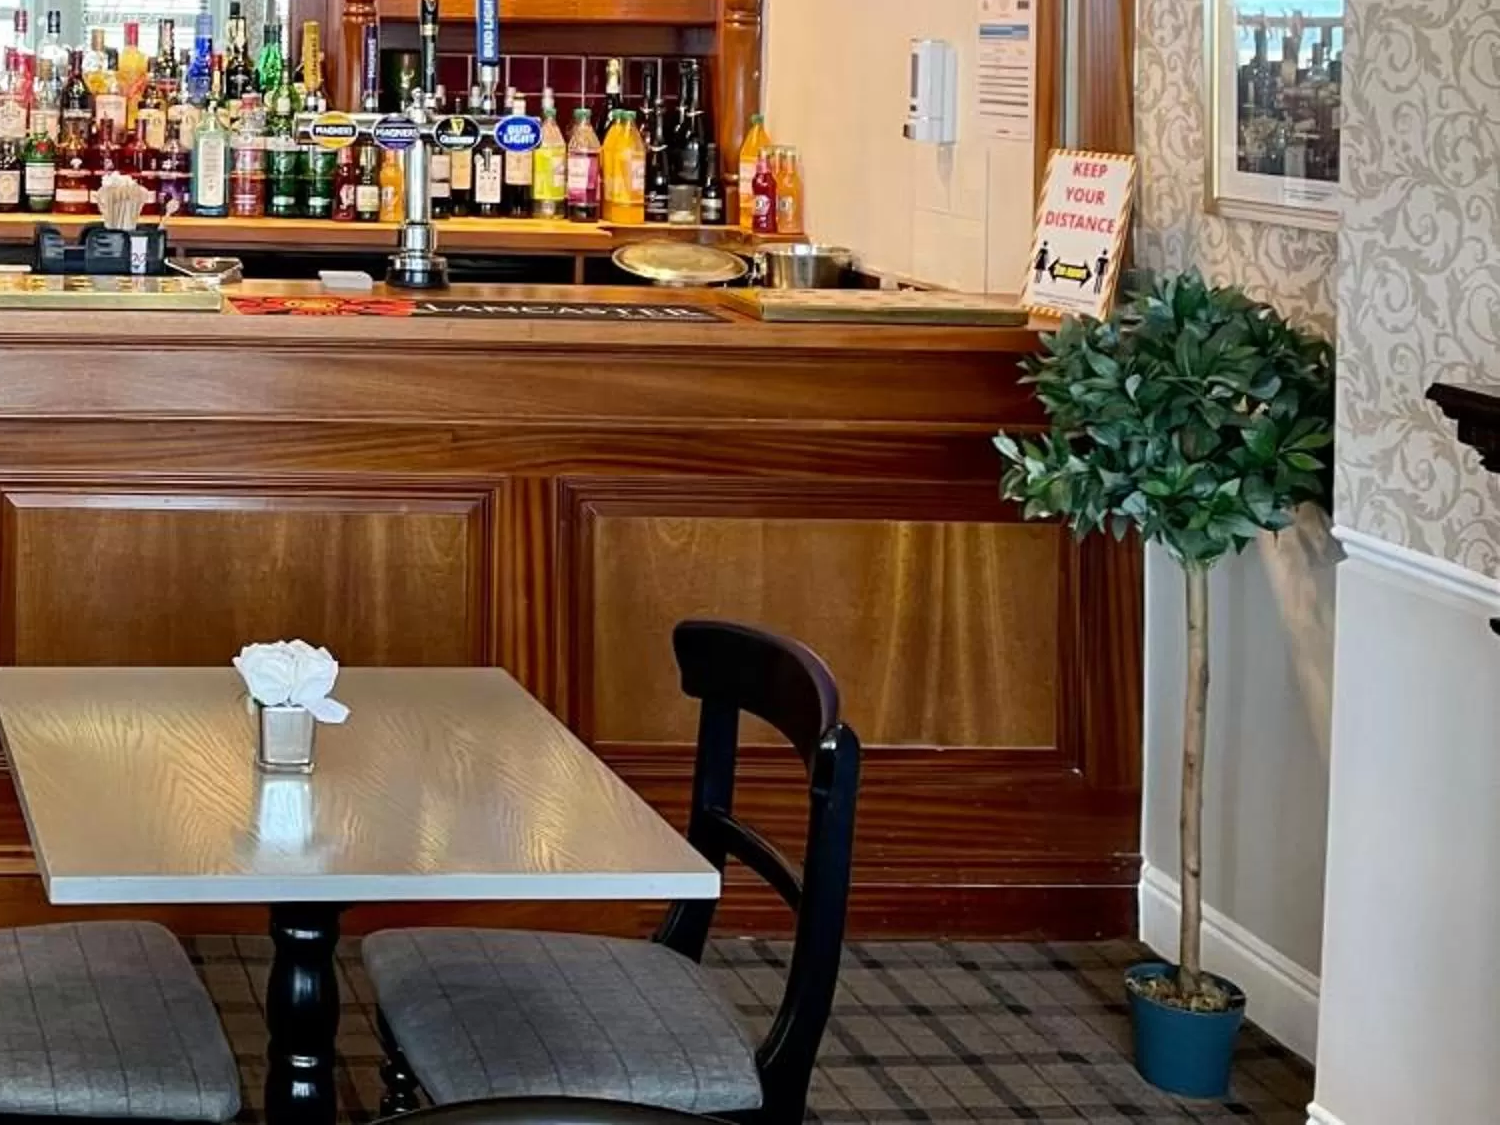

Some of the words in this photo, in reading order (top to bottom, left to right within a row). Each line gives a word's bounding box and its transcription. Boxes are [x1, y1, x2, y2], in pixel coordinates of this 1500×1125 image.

[482, 31, 495, 58] BUD
[376, 128, 418, 139] MAGNERS
[506, 123, 532, 135] BUD
[504, 133, 536, 144] LIGHT
[1072, 161, 1109, 178] KEEP
[1066, 186, 1106, 205] YOUR
[1045, 211, 1117, 234] DISTANCE
